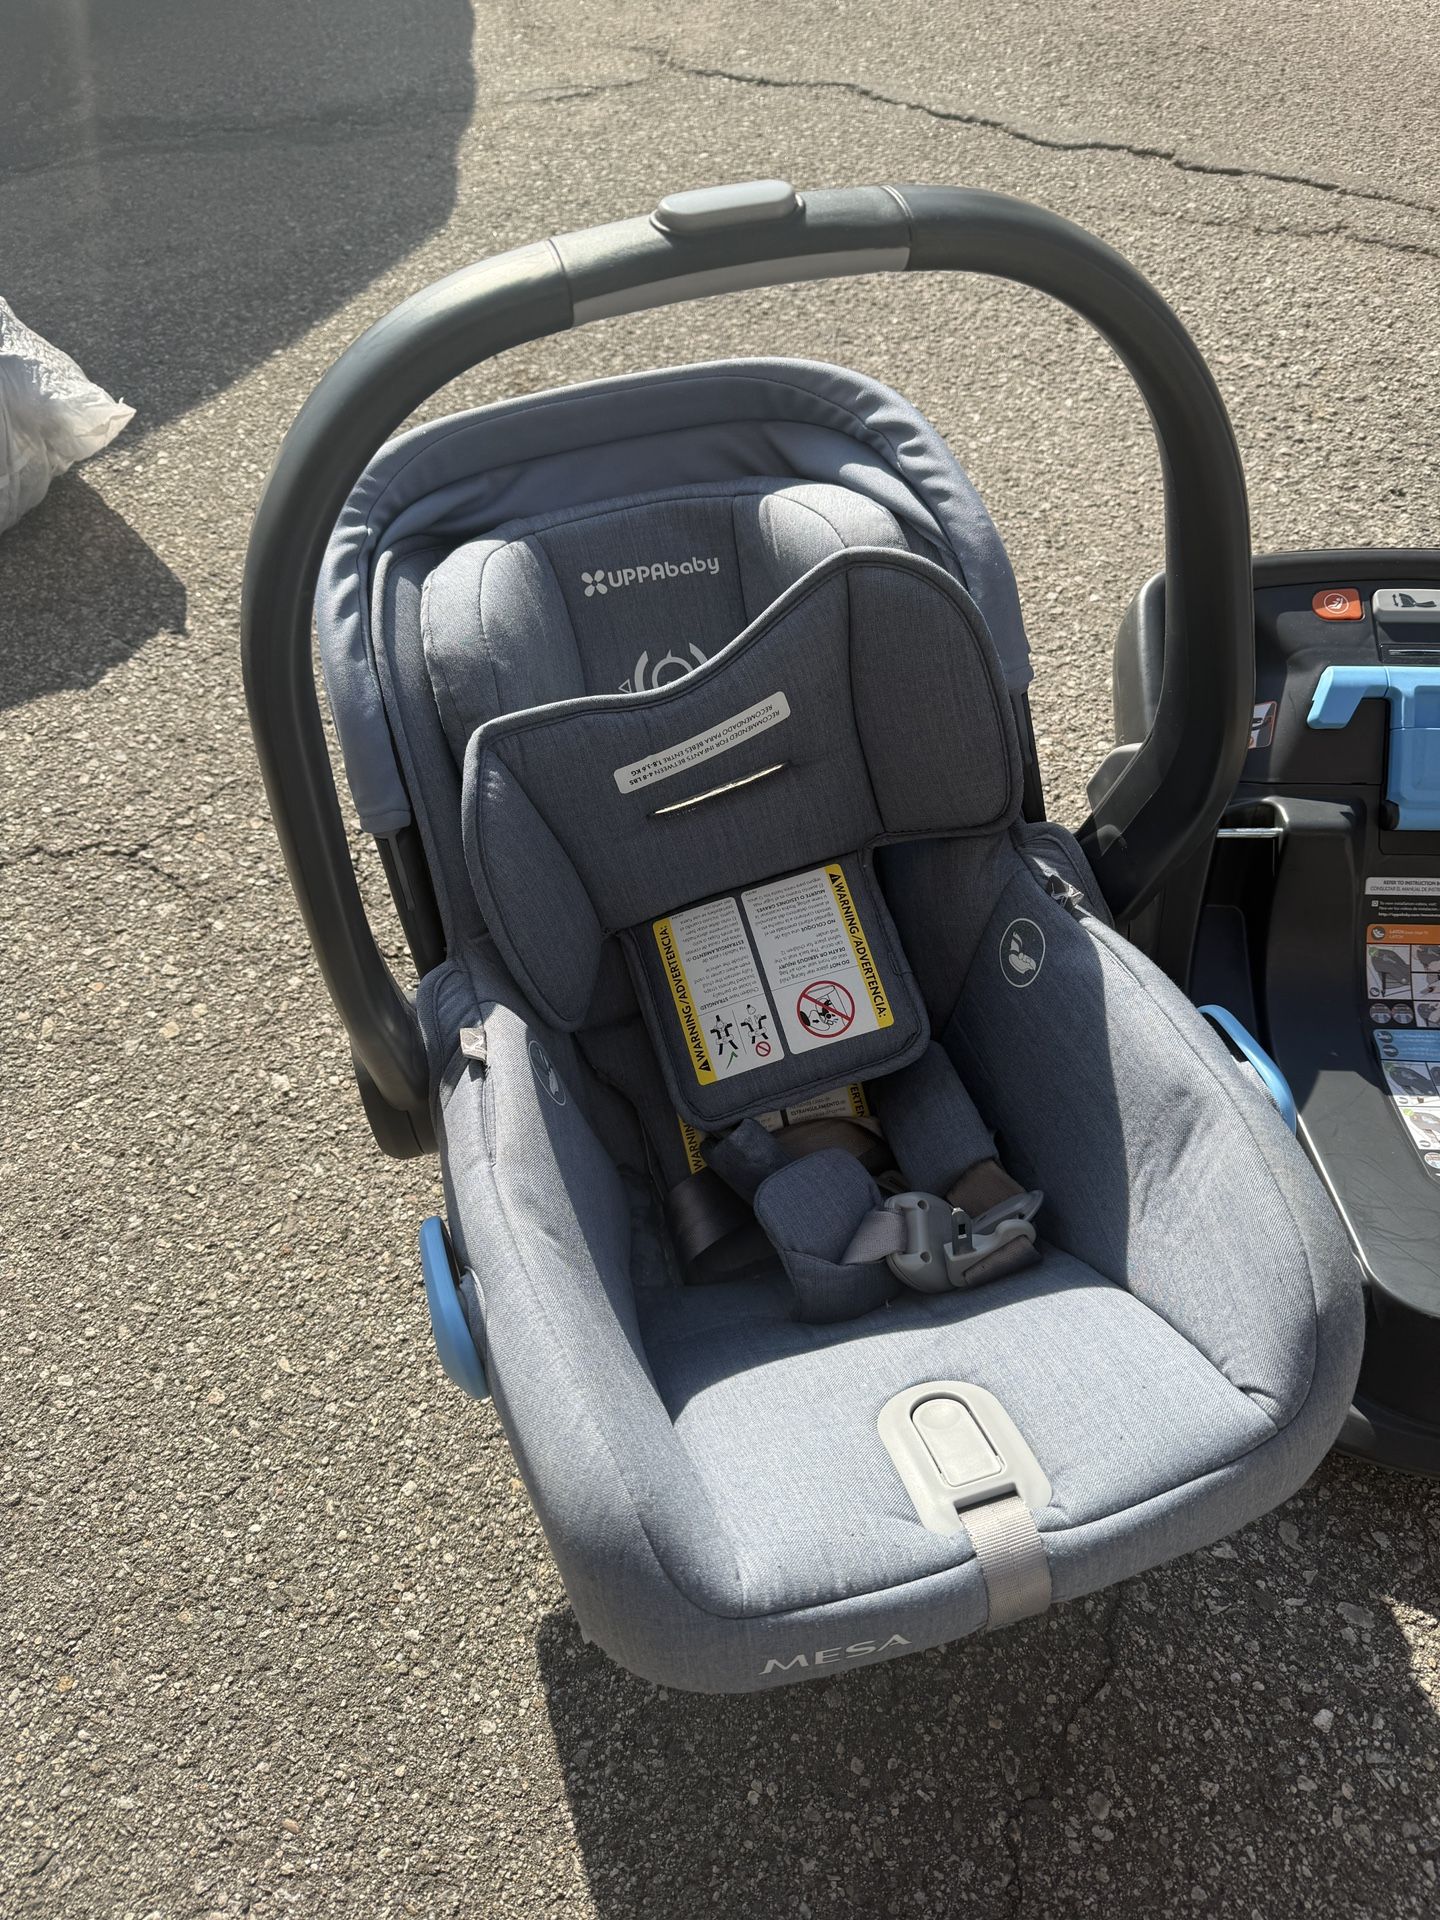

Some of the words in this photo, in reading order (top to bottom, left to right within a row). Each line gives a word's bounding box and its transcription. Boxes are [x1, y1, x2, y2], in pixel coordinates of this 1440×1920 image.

[607, 557, 720, 588] UPPAbaby
[721, 704, 773, 735] RECOMENDADO
[729, 709, 780, 740] RECOMMENDED
[704, 731, 721, 744] PARA
[714, 737, 729, 748] FOR
[662, 749, 684, 763] ENTRE
[686, 744, 714, 761] INFANTS
[630, 768, 641, 776] KG
[653, 757, 686, 775] BETWEEN
[628, 776, 641, 785] LBS
[775, 896, 799, 907] LESIONES
[800, 920, 826, 932] COLOQUE
[827, 946, 845, 955] DEATH
[833, 882, 888, 1017] WARNING/ADVERTENCIA:
[796, 954, 818, 964] SERIOUS
[657, 925, 706, 1061] WARNING/ADVERTENCIA:
[699, 996, 728, 1010] STRANGLED
[758, 1634, 912, 1675] MESA
